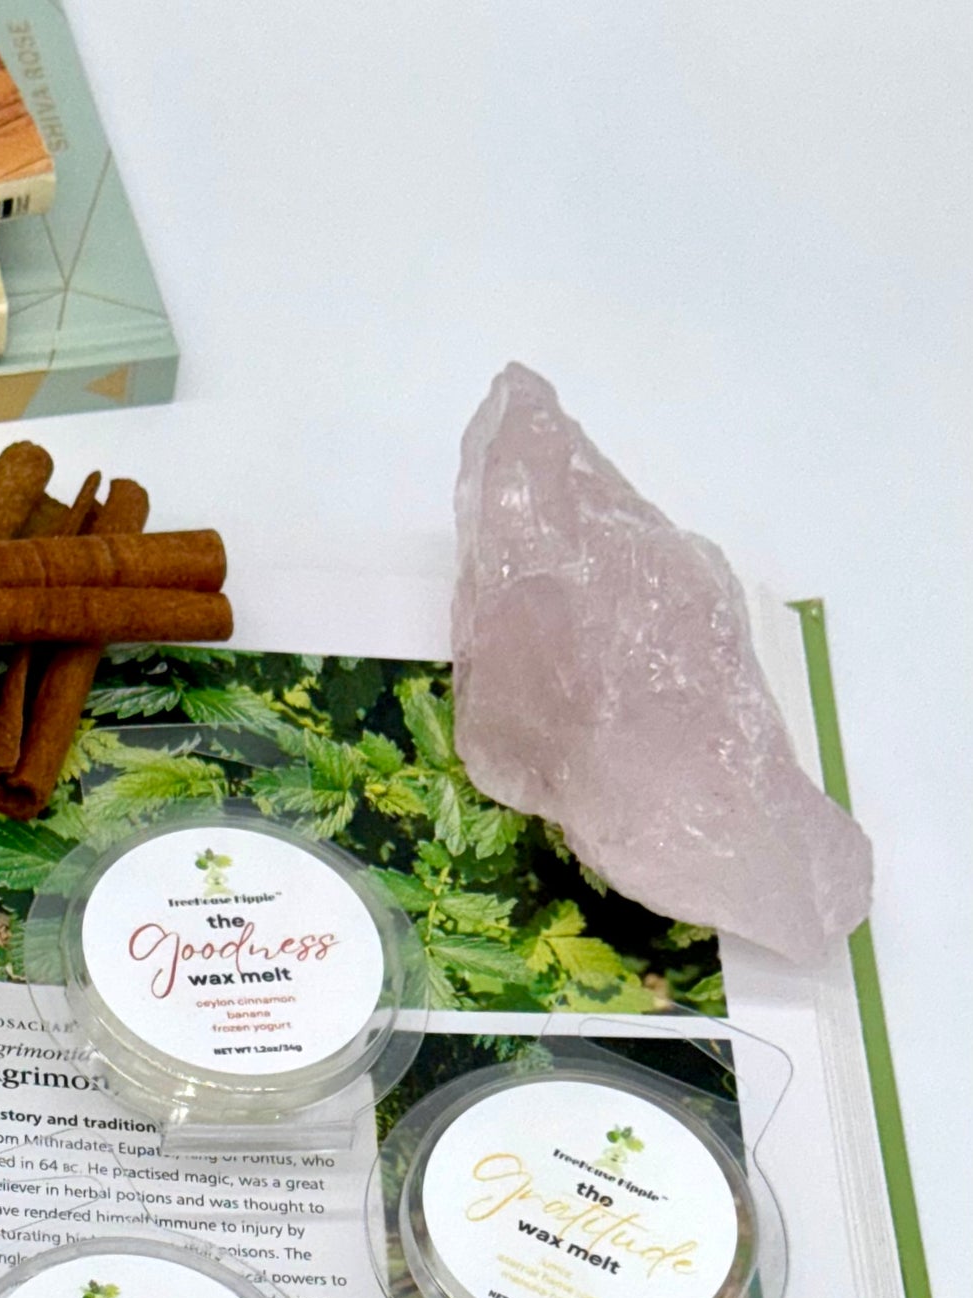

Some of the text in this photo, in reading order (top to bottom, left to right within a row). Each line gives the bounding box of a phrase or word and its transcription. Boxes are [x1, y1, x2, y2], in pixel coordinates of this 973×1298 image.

[207, 914, 245, 928] the
[188, 967, 292, 986] wax melt
[196, 995, 296, 1009] ceylon cinnamon
[227, 1009, 271, 1020] banana
[212, 1021, 292, 1033] frozen yogurt
[214, 1047, 233, 1055] NET
[235, 1046, 252, 1054] WT
[47, 1112, 78, 1127] and
[83, 1116, 156, 1134] tradition
[576, 1181, 614, 1208] the
[517, 1219, 564, 1249] wax
[566, 1243, 622, 1275] melt
